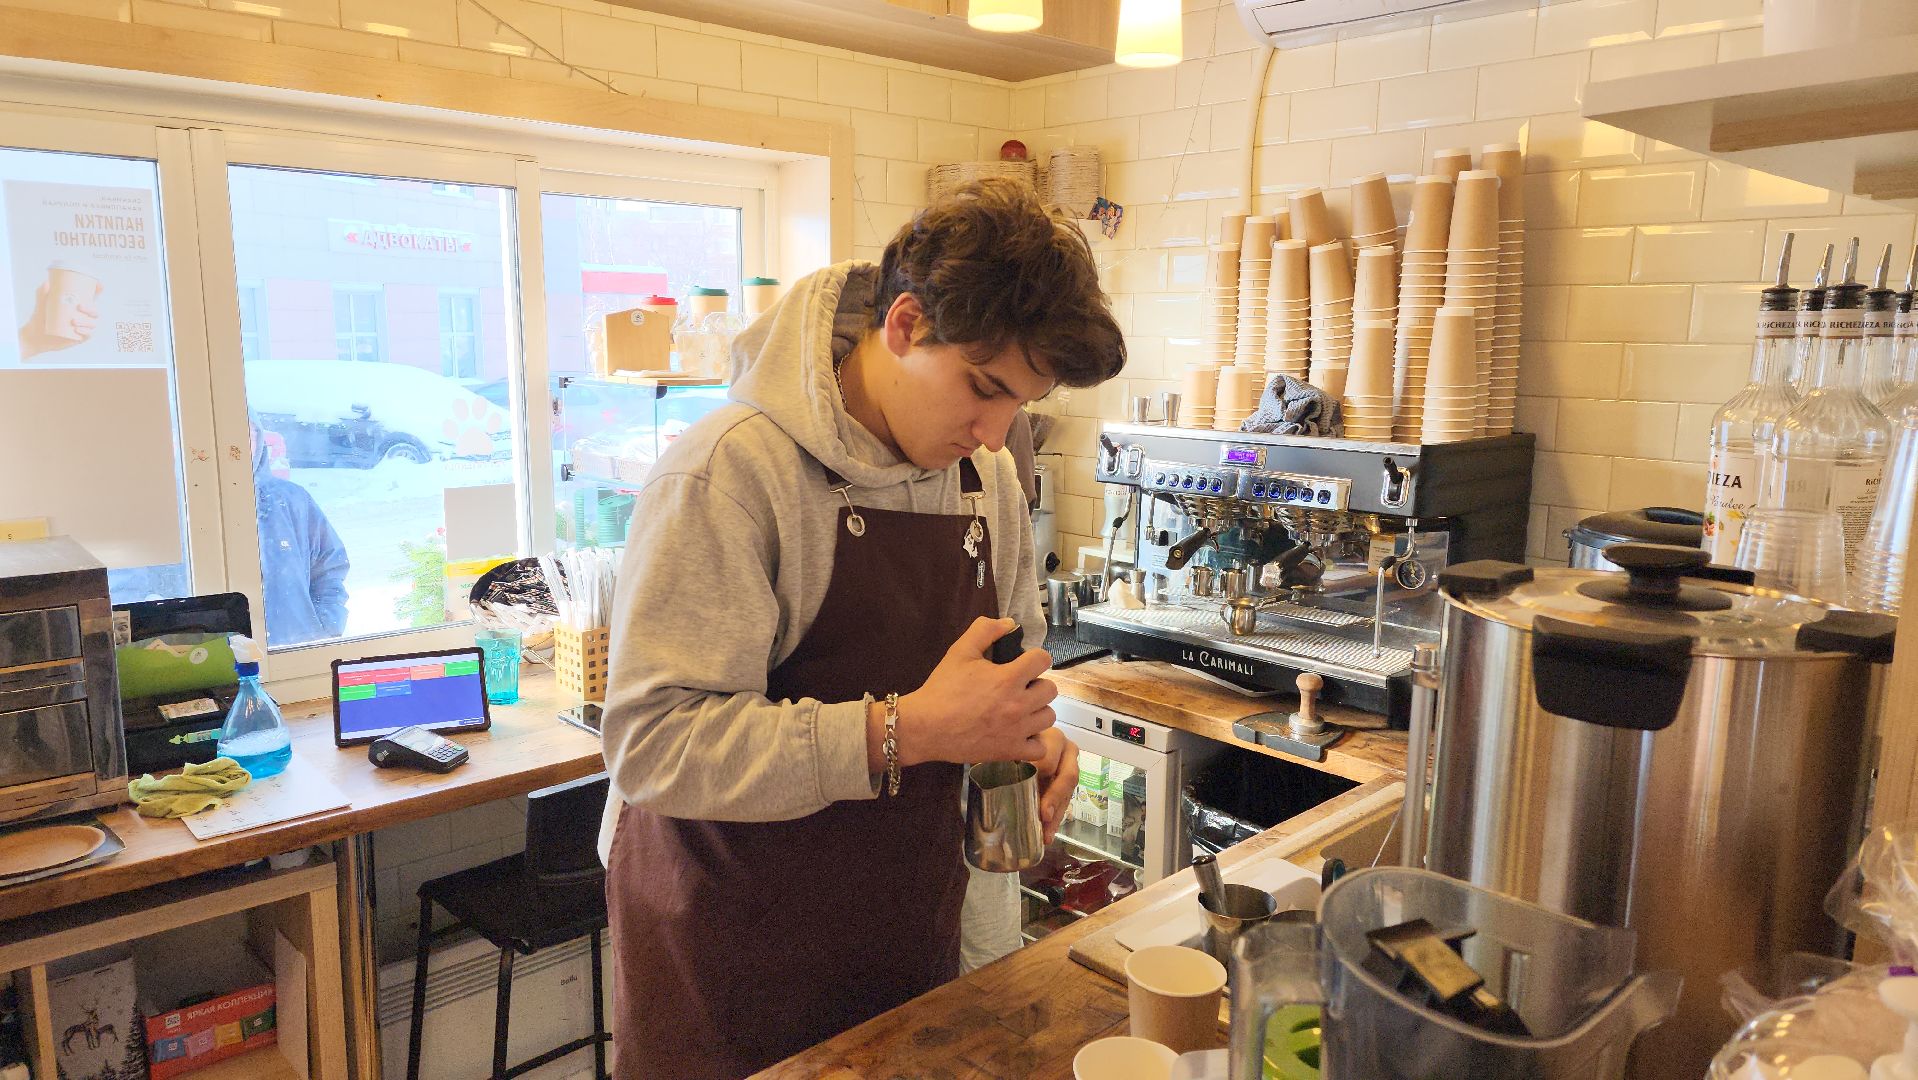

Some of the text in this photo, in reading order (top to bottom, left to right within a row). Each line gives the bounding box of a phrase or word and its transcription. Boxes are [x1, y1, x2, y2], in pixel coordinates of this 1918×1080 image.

[361, 231, 458, 253] АДВОКАТЫ
[1182, 649, 1254, 676] LA CARIMALI
[187, 988, 272, 1021] ЯРКАЯ КОЛЛЕКЦИЯ
